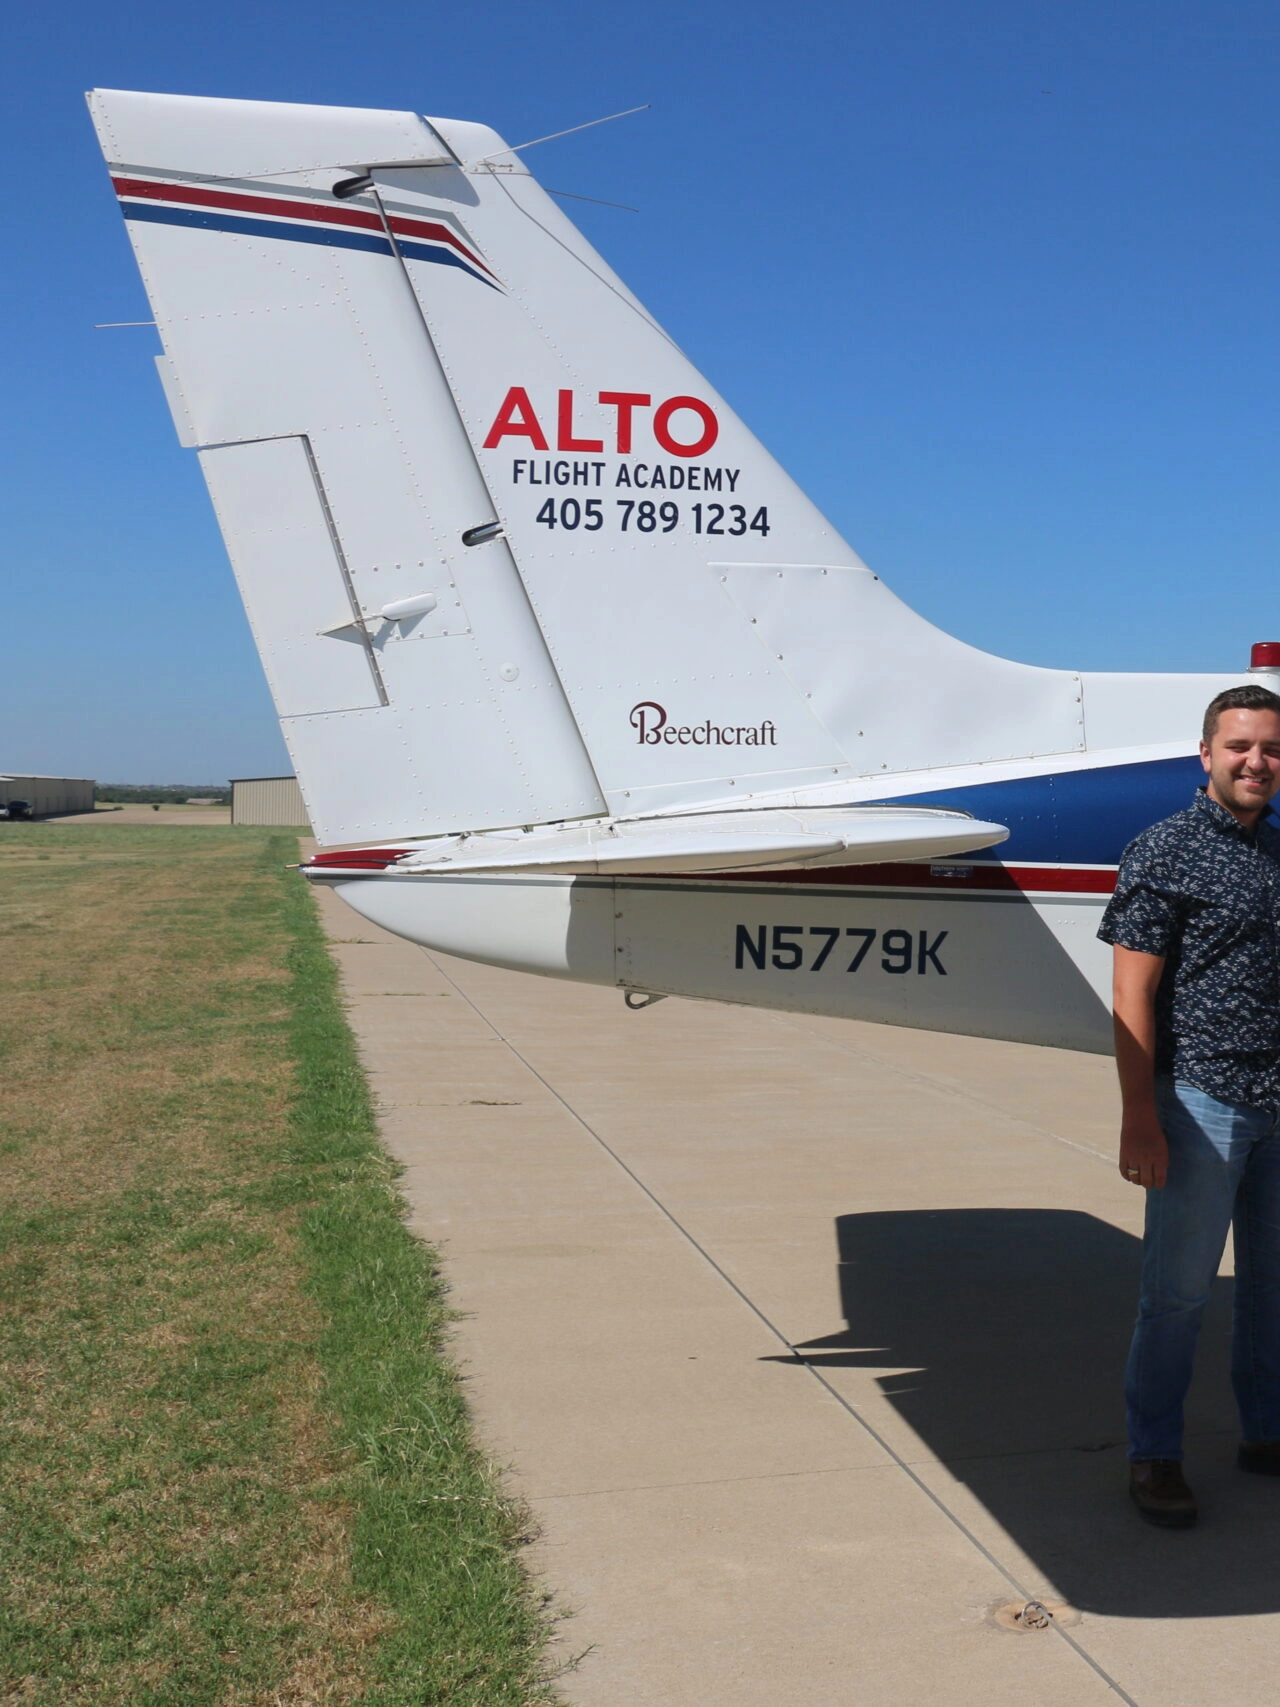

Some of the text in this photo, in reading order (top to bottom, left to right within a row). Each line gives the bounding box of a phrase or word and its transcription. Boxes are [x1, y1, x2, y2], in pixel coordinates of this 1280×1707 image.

[482, 386, 719, 458] ALTO
[512, 459, 741, 493] FLIGHT ACADEMY
[536, 498, 771, 537] 405 789 1234
[629, 701, 778, 746] Beechcraft
[734, 924, 949, 976] N5779K
